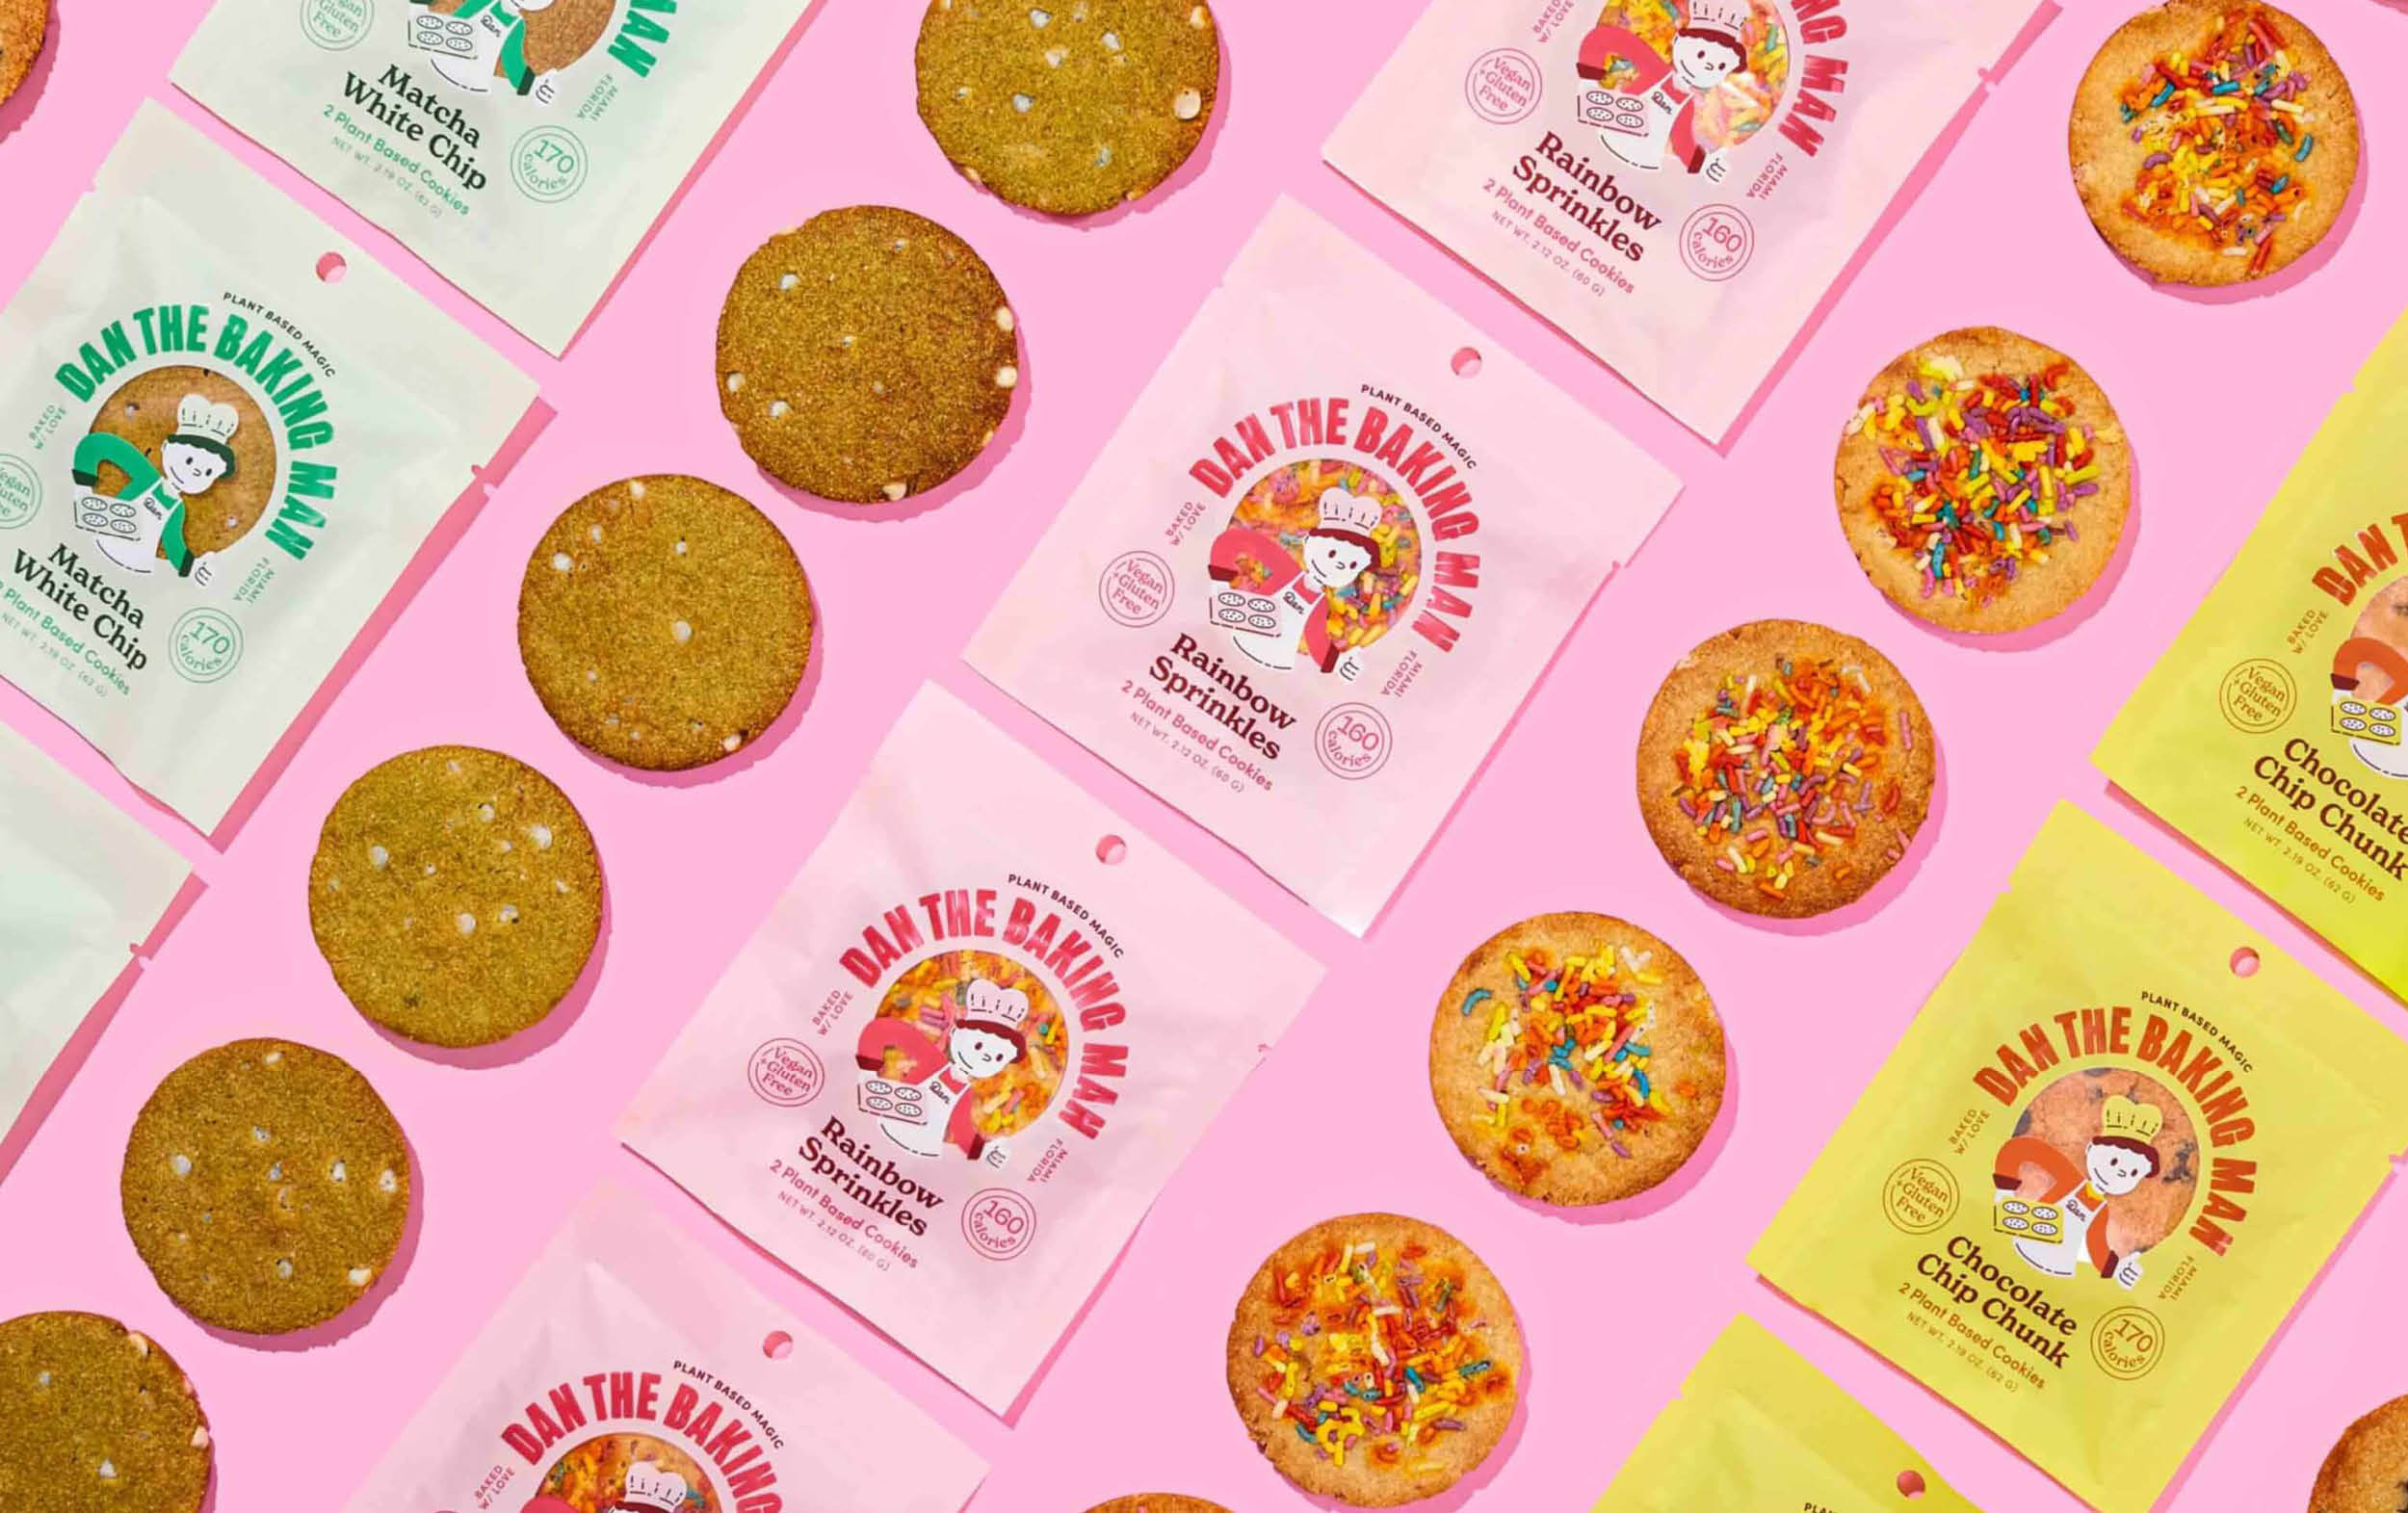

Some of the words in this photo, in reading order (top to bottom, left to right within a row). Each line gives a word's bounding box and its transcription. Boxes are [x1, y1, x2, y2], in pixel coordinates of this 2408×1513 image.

[608, 0, 677, 77] AN
[1492, 56, 1531, 91] Vegan
[342, 72, 425, 143] White
[429, 136, 487, 192] Chip
[379, 65, 482, 148] Matcha
[1479, 84, 1509, 111] Free
[1778, 54, 1848, 157] MAN
[323, 104, 335, 117] 2
[335, 111, 373, 146] Plant
[371, 136, 420, 175] Based
[419, 170, 470, 216] Cookies
[535, 139, 574, 176] 170
[1535, 131, 1662, 230] Rainbow
[1482, 179, 1495, 192] 2
[1495, 186, 1534, 221] Plant
[1533, 214, 1580, 252] Based
[1579, 248, 1635, 293] Cookies
[1512, 155, 1645, 262] Sprinkles
[1701, 216, 1741, 252] 160
[55, 321, 138, 403] DAN
[133, 303, 210, 355] THE
[222, 292, 263, 315] PLANT
[264, 310, 302, 342] BASED
[302, 340, 336, 378] MAGIC
[213, 313, 334, 451] BAKING
[1270, 398, 1348, 449] THE
[1189, 414, 1275, 498] DAN
[1361, 384, 1401, 406] PLANT
[1402, 402, 1441, 434] BASED
[1442, 431, 1477, 470] MAGIC
[265, 461, 337, 561] MAN
[1354, 405, 1480, 542] BAKING
[48, 542, 145, 629] Matcha
[1112, 587, 1142, 615] Free
[1126, 560, 1164, 594] Vegan
[1412, 551, 1480, 653] MAN
[2311, 523, 2398, 607] DAN
[4, 588, 40, 623] Plant
[40, 615, 84, 653] Based
[84, 648, 130, 694] Cookies
[13, 548, 90, 622] White
[92, 613, 147, 671] Chip
[191, 621, 231, 656] 170
[1149, 656, 1280, 761] Sprinkles
[1169, 633, 1296, 731] Rainbow
[2233, 695, 2264, 722] Free
[2246, 666, 2285, 702] Vegan
[1120, 680, 1134, 693] 2
[1133, 688, 1168, 722] Plant
[1171, 714, 1219, 752] Based
[1217, 744, 1272, 791] Cookies
[1337, 716, 1379, 752] 160
[2254, 756, 2316, 810] Chip
[2318, 803, 2408, 881] Chunk
[2284, 738, 2408, 845] Chocolate
[2235, 786, 2246, 799] 2
[2247, 793, 2284, 826] Plant
[2284, 819, 2331, 860] Based
[2330, 855, 2386, 902] Cookies
[839, 904, 924, 988] DAN
[919, 889, 996, 941] THE
[1008, 874, 1049, 895] PLANT
[1051, 890, 1088, 921] BASED
[1088, 920, 1124, 959] MAGIC
[1002, 897, 1126, 1032] BAKING
[773, 1046, 813, 1079] Vegan
[1973, 1024, 2059, 1107] DAN
[2055, 1005, 2132, 1058] THE
[2141, 991, 2179, 1011] PLANT
[2181, 1007, 2218, 1037] BASED
[2218, 1034, 2254, 1073] MAGIC
[762, 1073, 794, 1096] Free
[1059, 1042, 1128, 1140] MAN
[2136, 1013, 2255, 1149] BAKING
[798, 1136, 929, 1238] Sprinkles
[820, 1115, 944, 1211] Rainbow
[1910, 1166, 1949, 1202] Vegan
[770, 1160, 782, 1172] 2
[781, 1166, 819, 1201] Plant
[819, 1192, 865, 1230] Based
[864, 1225, 918, 1269] Cookies
[982, 1200, 1024, 1236] 160
[1896, 1196, 1927, 1223] Free
[2188, 1158, 2257, 1257] MAN
[1917, 1253, 1979, 1306] Chip
[1981, 1298, 2070, 1369] Chunk
[1947, 1237, 2078, 1337] Chocolate
[1898, 1283, 1910, 1295] 2
[1910, 1290, 1948, 1322] Plant
[1948, 1315, 1994, 1351] Based
[1992, 1345, 2046, 1390] Cookies
[2113, 1318, 2154, 1354] 170
[501, 1383, 588, 1466] DAN
[583, 1371, 662, 1421] THE
[673, 1360, 713, 1383] PLANT
[714, 1379, 751, 1411] BASED
[750, 1410, 784, 1449] MAGIC
